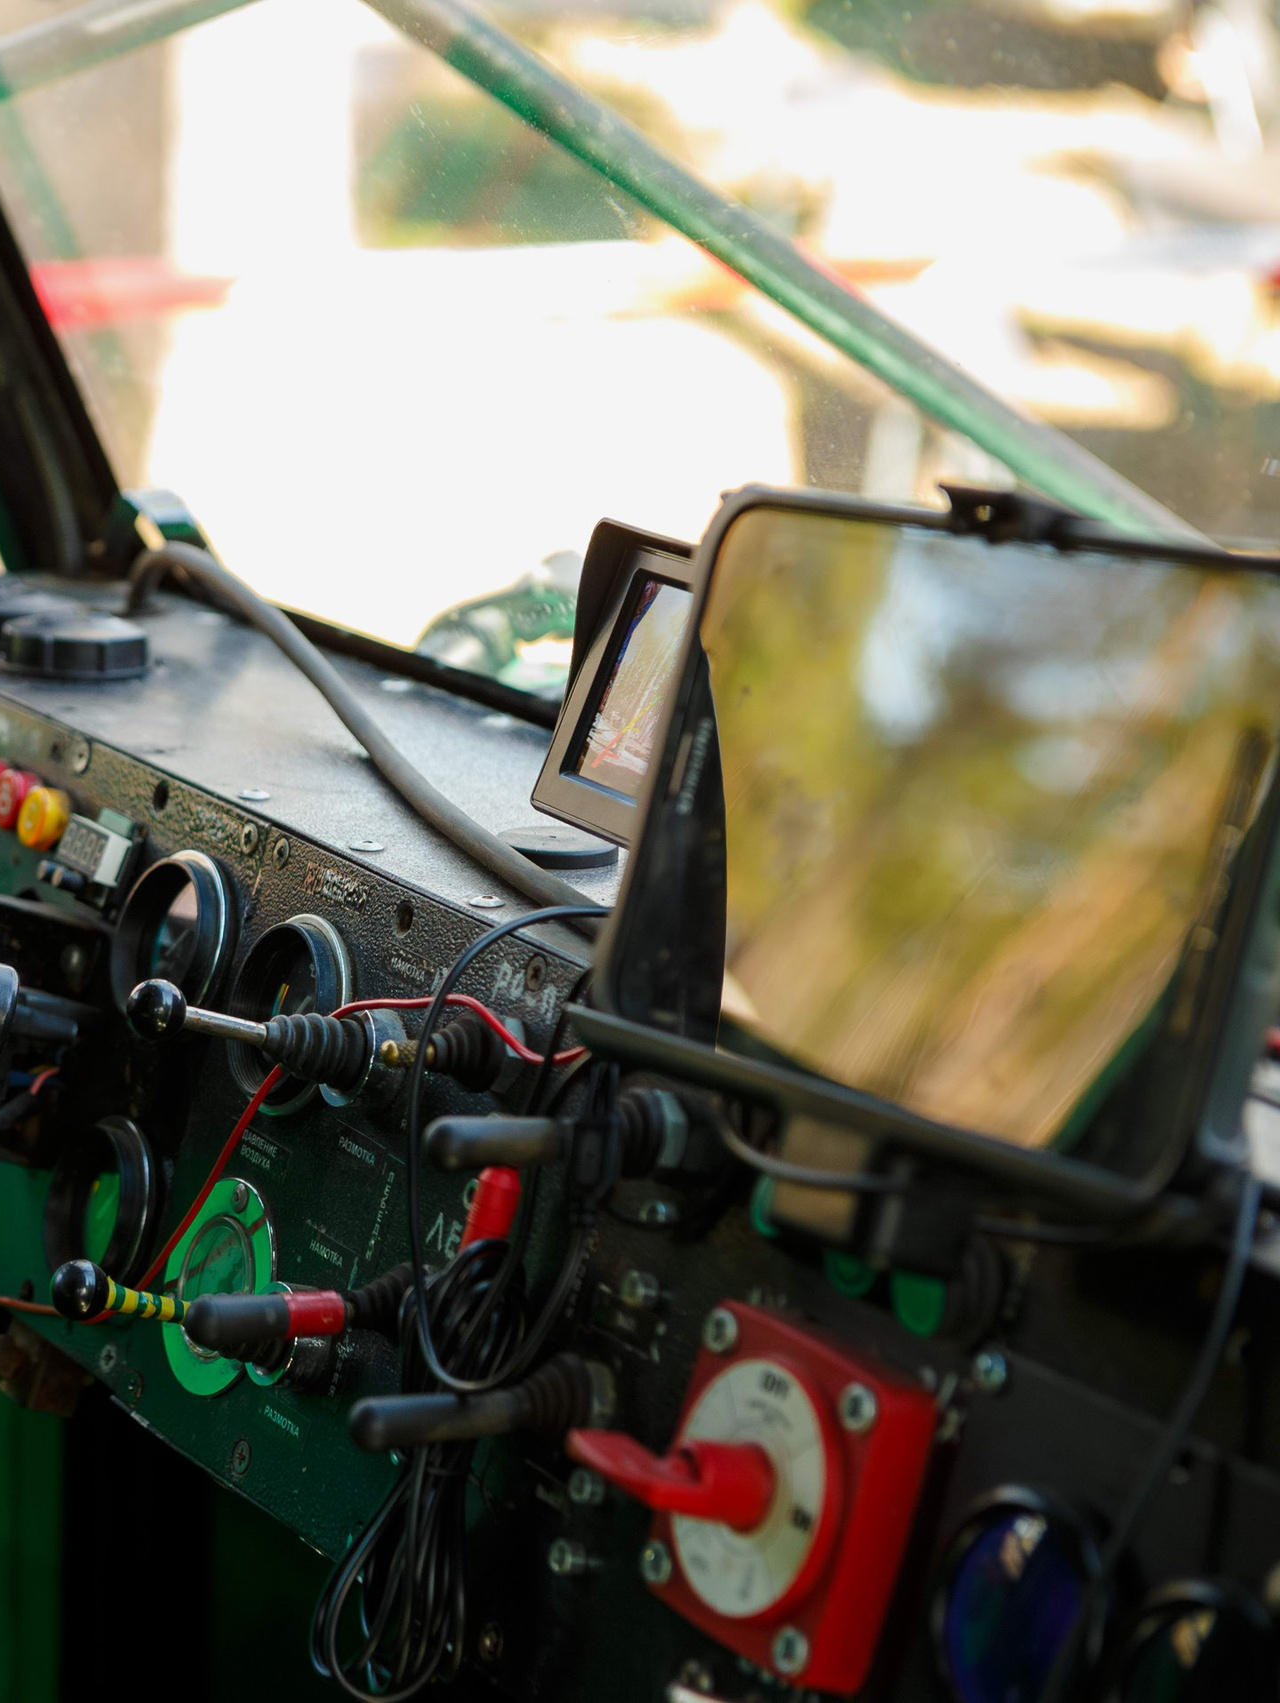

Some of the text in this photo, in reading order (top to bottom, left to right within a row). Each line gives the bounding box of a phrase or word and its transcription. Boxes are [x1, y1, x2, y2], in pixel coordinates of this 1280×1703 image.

[240, 1144, 271, 1170] ВОЗДУХА
[242, 1129, 279, 1158] ДАВЛЕНИЕ
[338, 1136, 376, 1165] РАЗМОТКА
[309, 1239, 344, 1267] НАМОТКА
[263, 1405, 300, 1437] РАЗМОТКА
